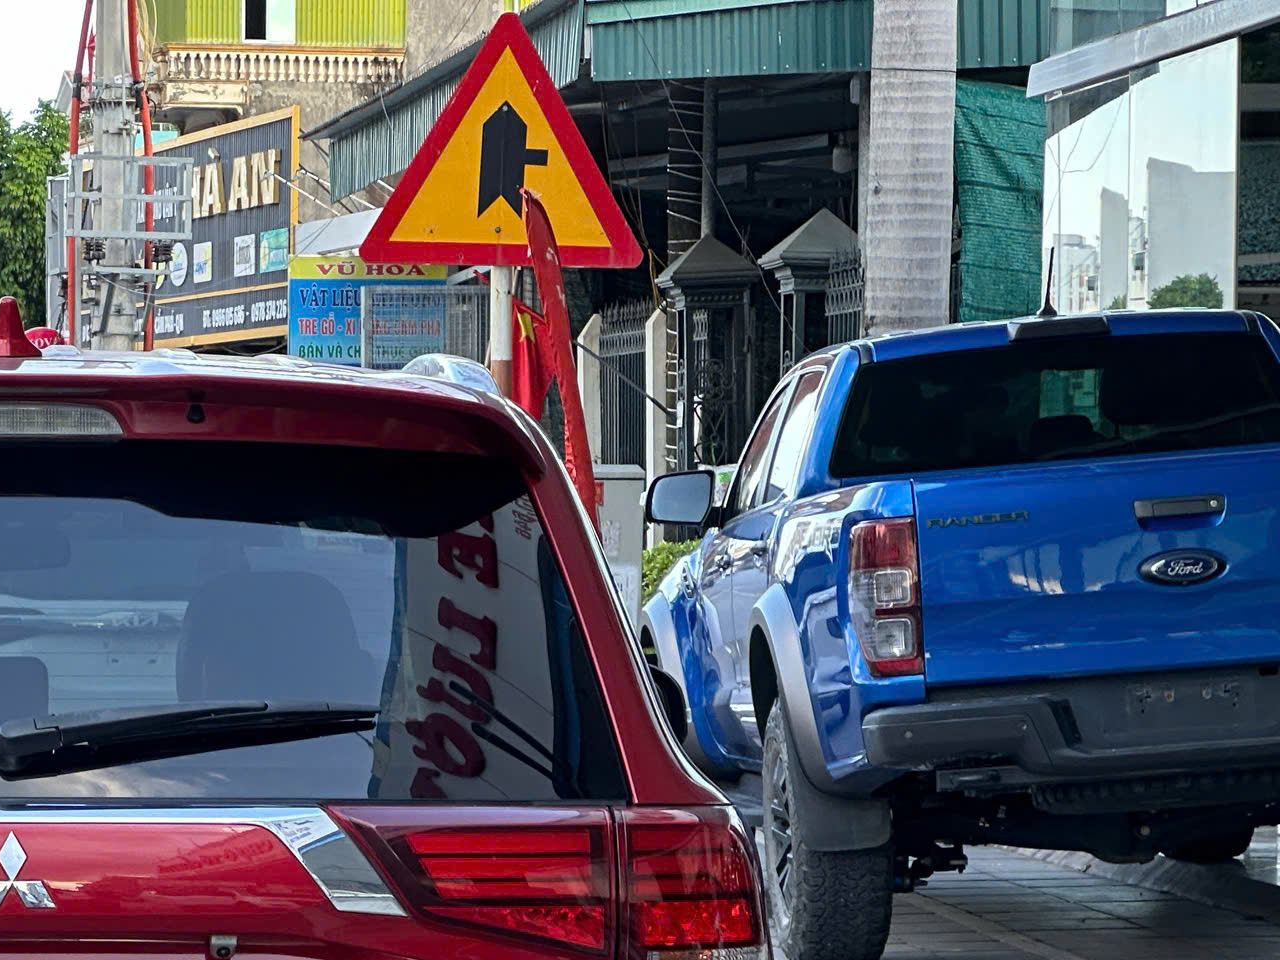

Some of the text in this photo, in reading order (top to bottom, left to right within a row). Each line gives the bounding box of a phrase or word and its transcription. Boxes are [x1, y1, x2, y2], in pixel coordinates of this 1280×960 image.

[228, 149, 281, 211] AN
[316, 260, 356, 276] VŨ
[300, 283, 330, 311] VẬT
[332, 283, 361, 311] LIỆU
[298, 318, 317, 335] TRE
[321, 312, 335, 335] GỖ
[345, 318, 356, 335] XI
[326, 342, 343, 358] VÀ
[1167, 559, 1204, 576] Ford
